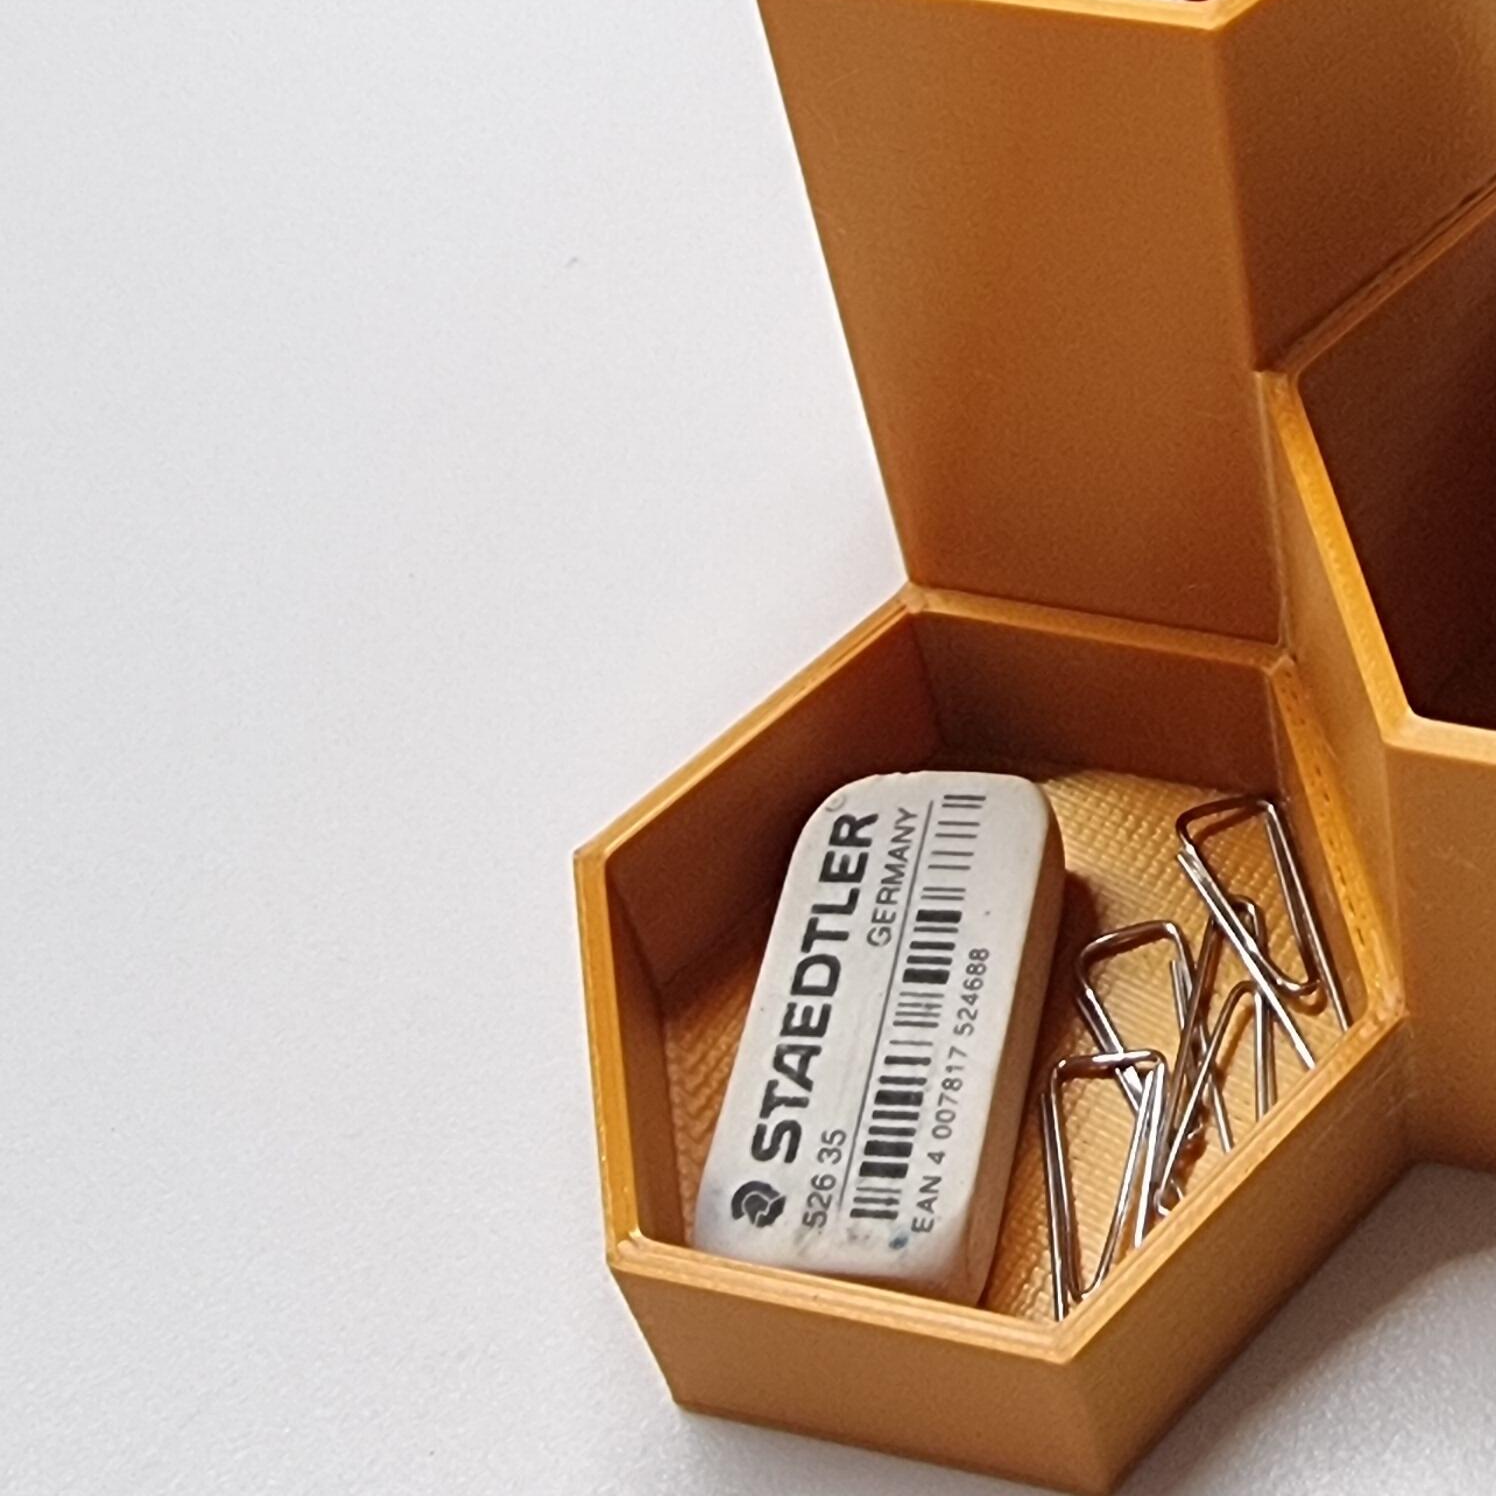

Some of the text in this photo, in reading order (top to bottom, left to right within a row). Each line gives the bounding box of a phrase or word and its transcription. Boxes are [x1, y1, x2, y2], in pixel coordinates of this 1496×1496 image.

[866, 807, 919, 947] GERMANY
[750, 813, 879, 1165] STAEDTLER
[911, 947, 991, 1234] EAN 4 007817 524688
[801, 1128, 848, 1229] 526 35
